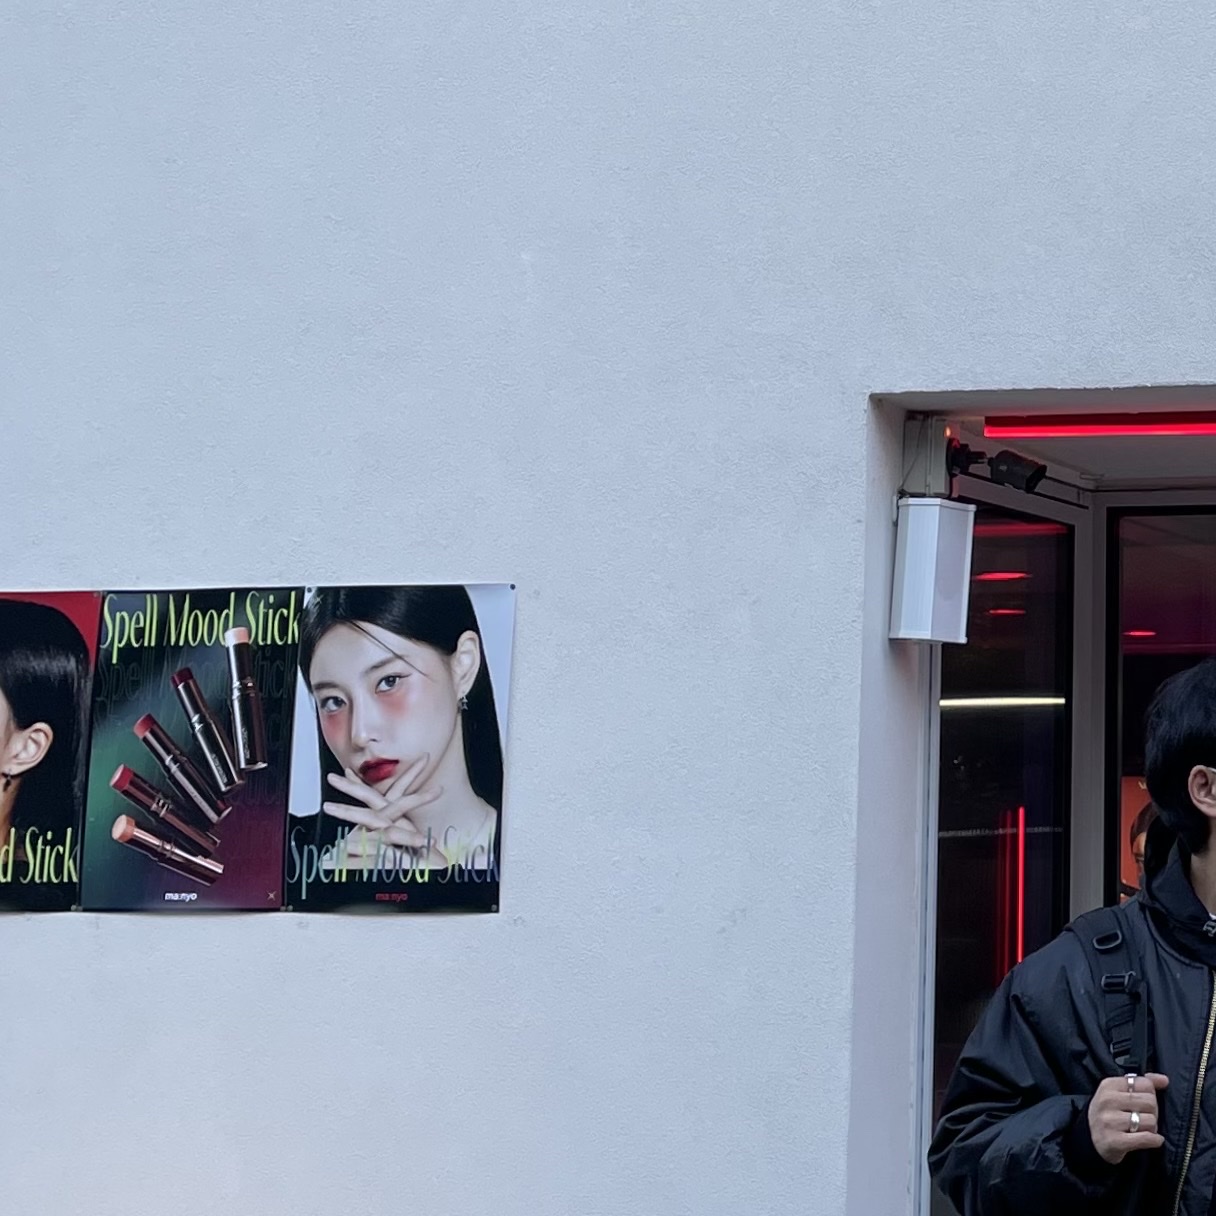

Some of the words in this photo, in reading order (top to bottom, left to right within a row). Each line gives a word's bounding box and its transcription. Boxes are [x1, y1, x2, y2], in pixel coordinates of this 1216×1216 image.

[100, 593, 158, 664] Spell
[163, 591, 235, 647] Mood
[245, 590, 300, 648] Stick
[19, 826, 80, 884] Stick
[286, 825, 349, 900] Spell
[355, 825, 432, 884] Mood
